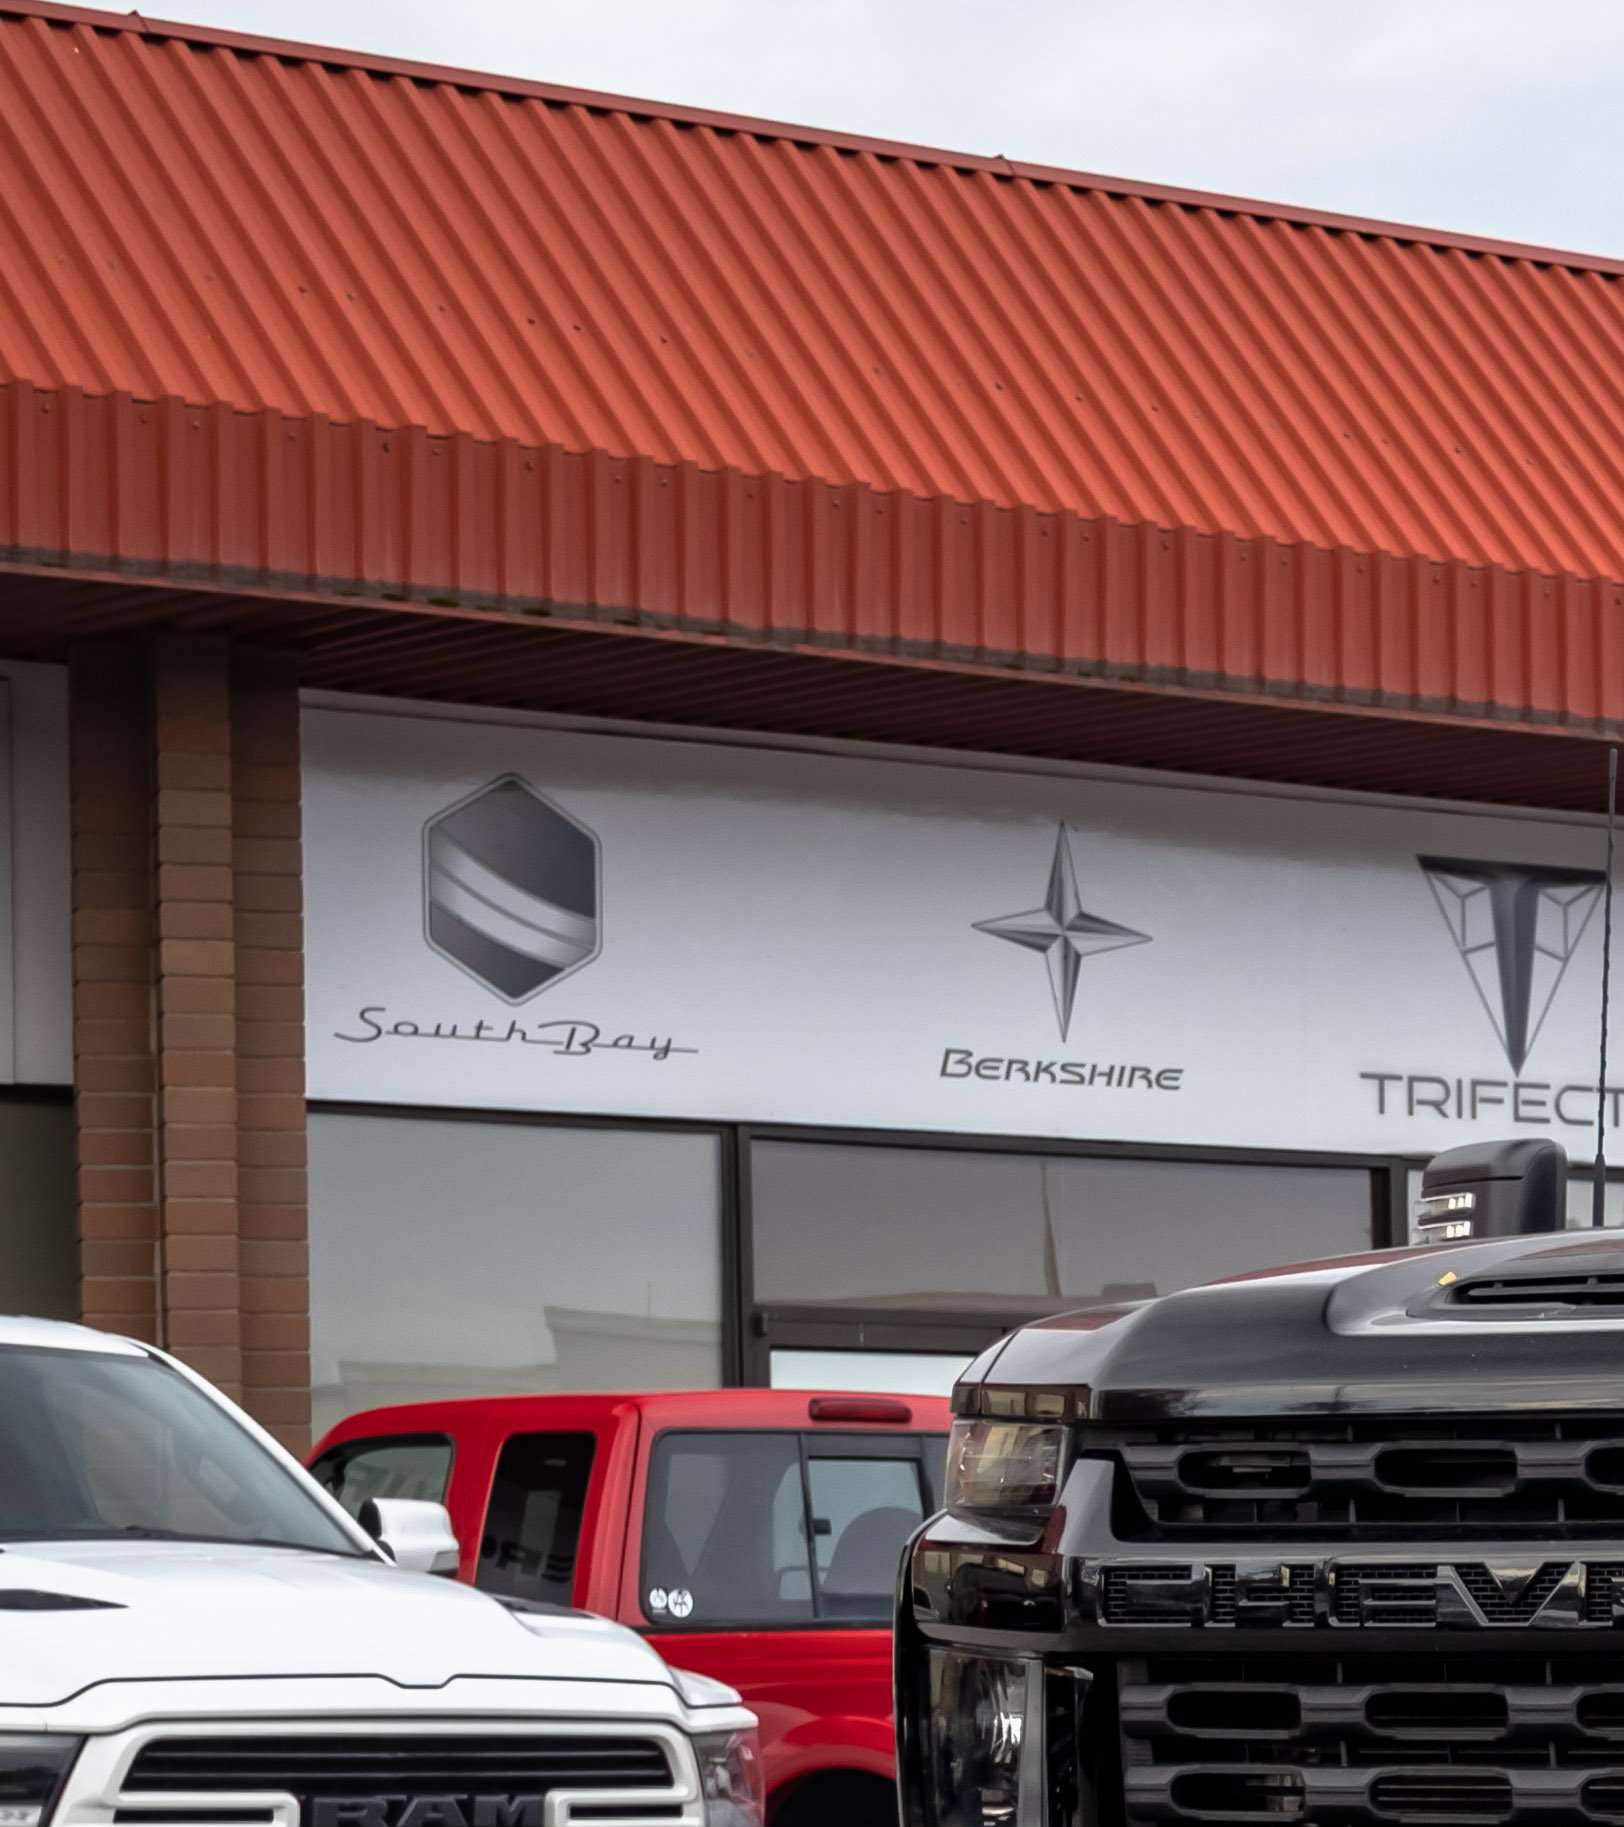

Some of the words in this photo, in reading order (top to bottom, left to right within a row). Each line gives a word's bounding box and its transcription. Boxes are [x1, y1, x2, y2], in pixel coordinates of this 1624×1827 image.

[334, 1006, 530, 1043] South
[537, 1020, 699, 1060] Bay
[940, 1047, 1184, 1091] BERKSHIRE
